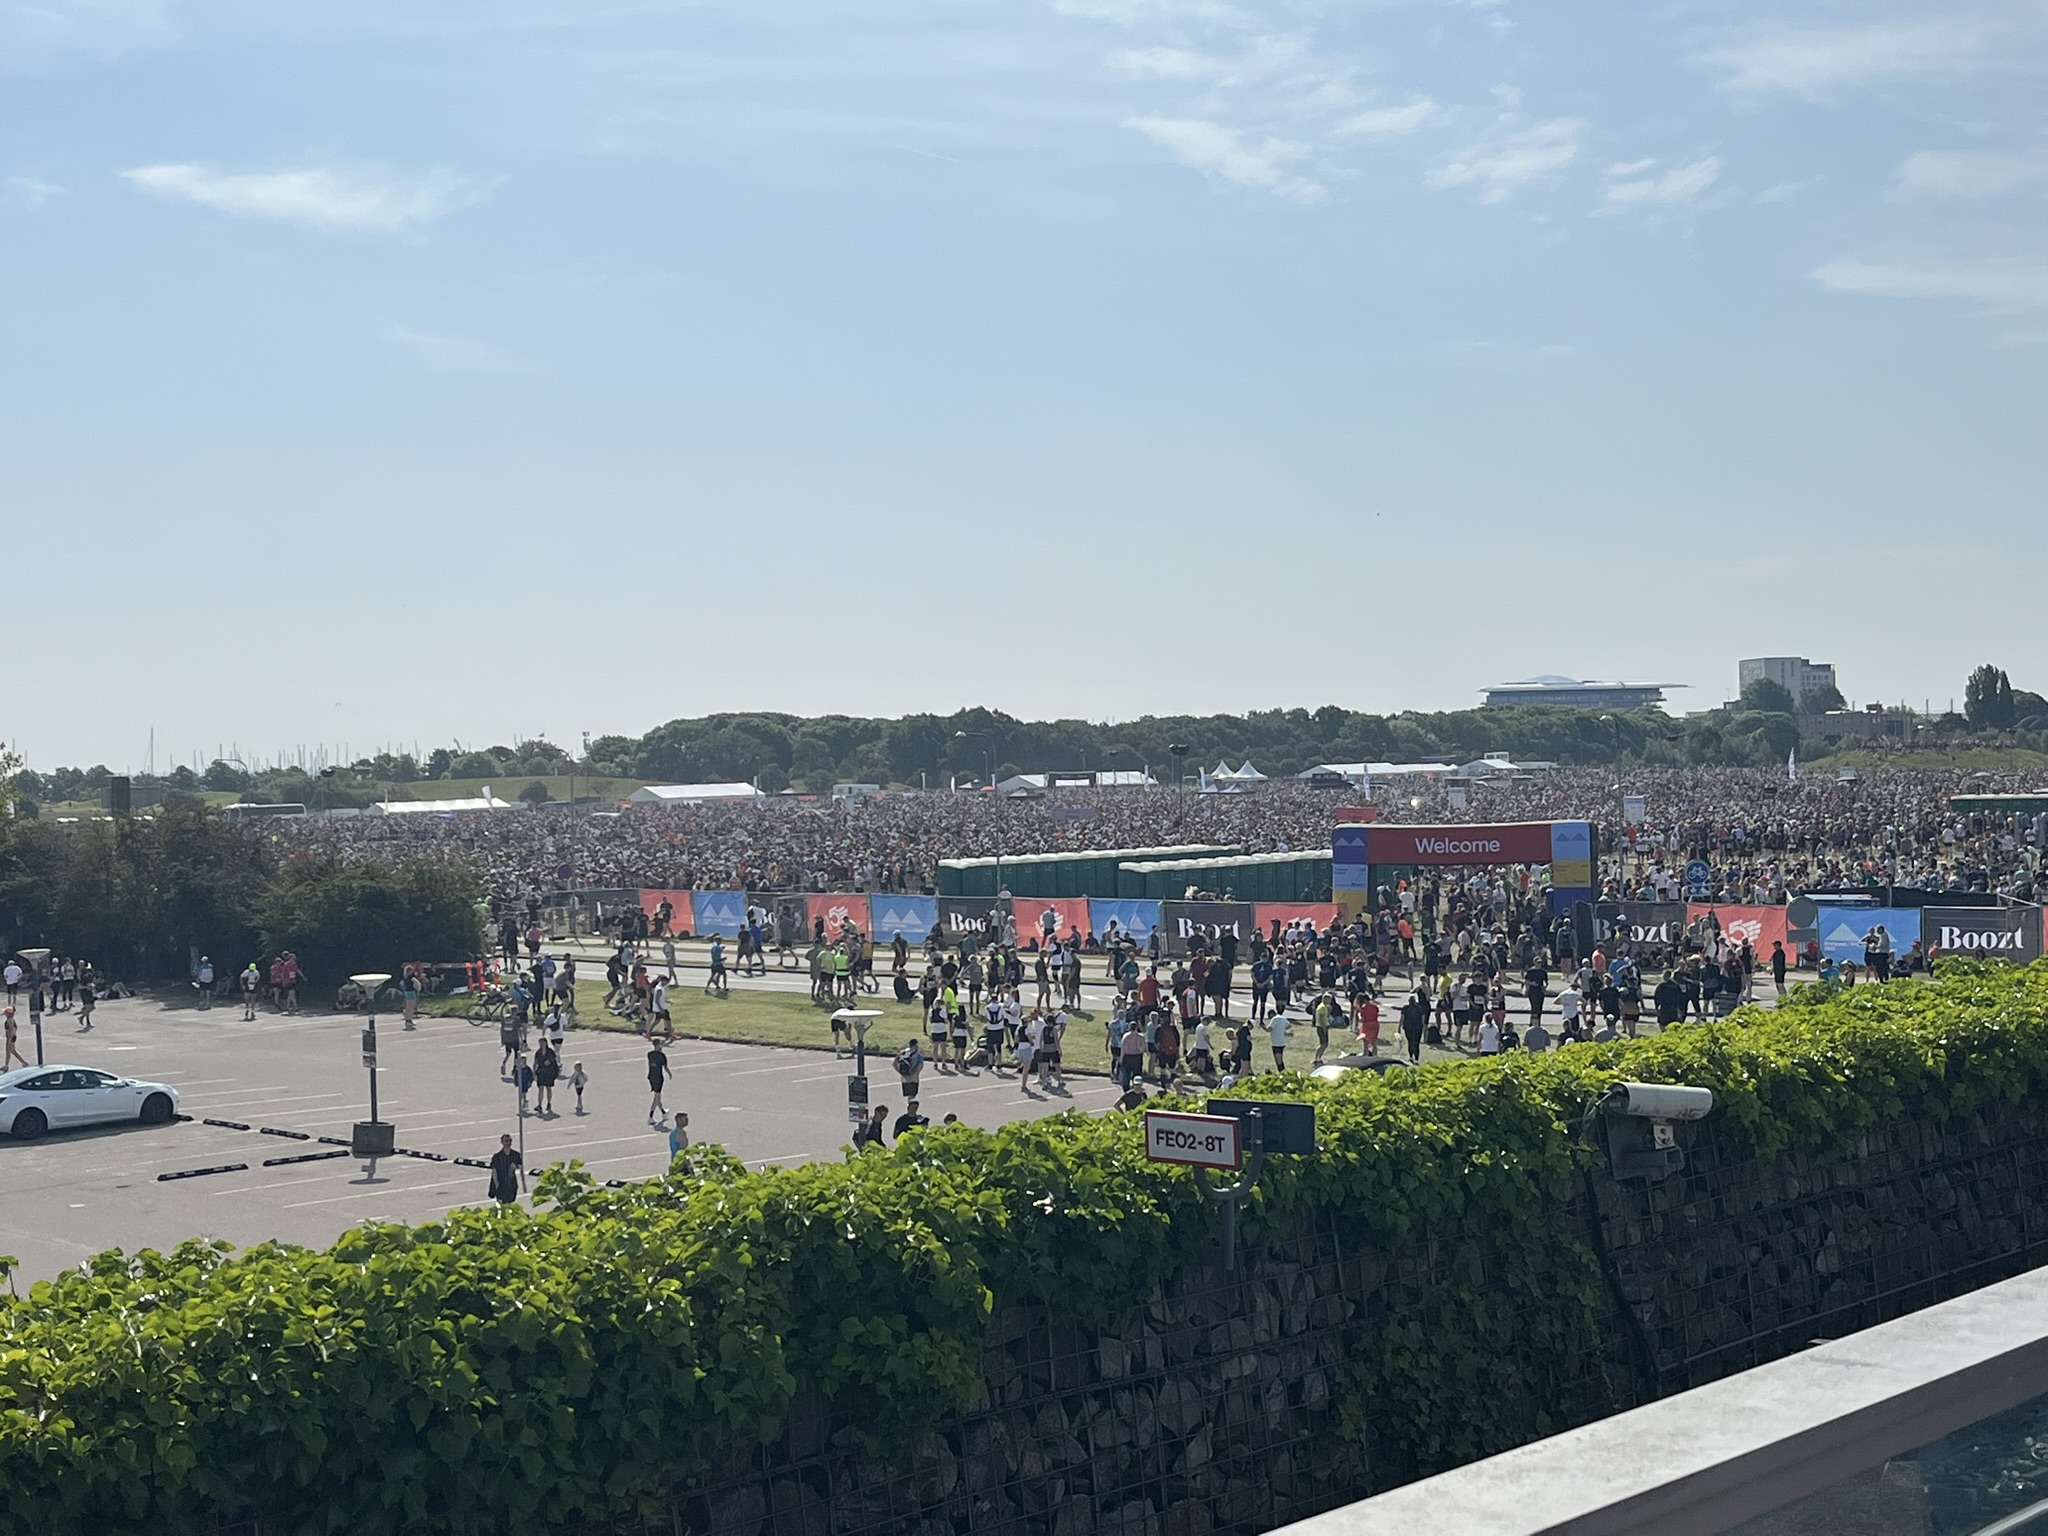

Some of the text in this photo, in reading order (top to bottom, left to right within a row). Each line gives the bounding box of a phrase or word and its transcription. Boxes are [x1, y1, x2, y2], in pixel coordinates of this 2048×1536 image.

[1415, 837, 1500, 854] Welcome
[1596, 919, 1670, 942] Bozt
[1940, 926, 2025, 950] Boozt
